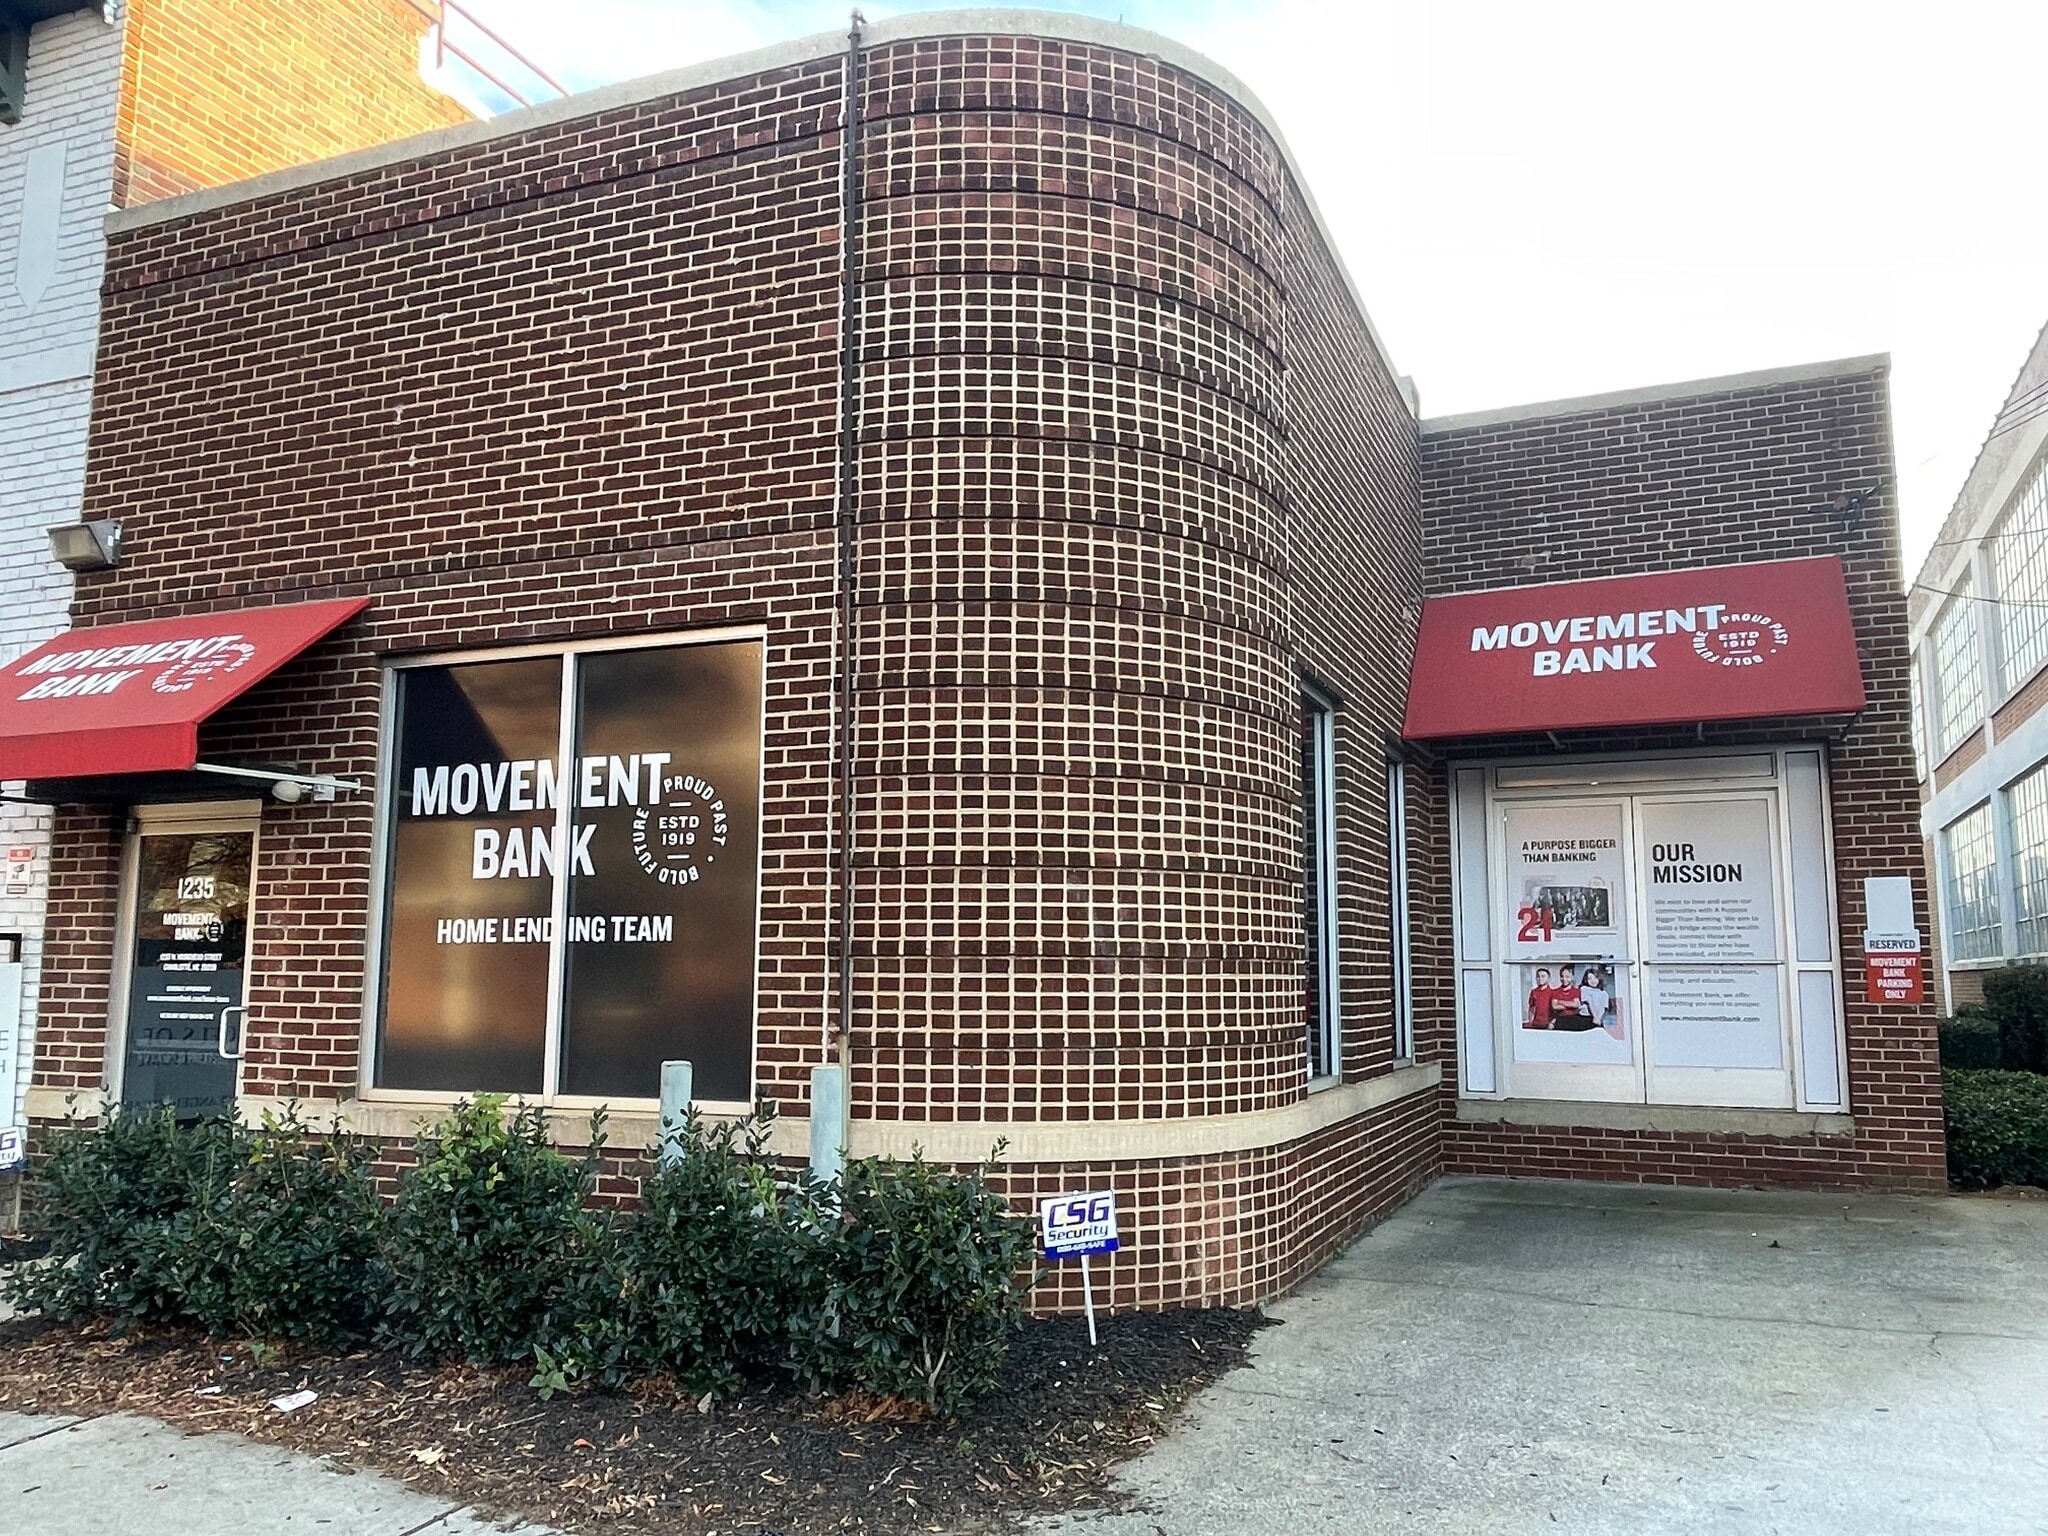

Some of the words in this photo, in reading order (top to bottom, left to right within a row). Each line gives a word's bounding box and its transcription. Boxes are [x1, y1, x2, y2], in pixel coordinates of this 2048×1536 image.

[1470, 604, 1726, 652] MOVEMENT
[1721, 613, 1772, 625] PROUD
[1768, 623, 1788, 645] PAST
[15, 634, 244, 677] MOVEMENT
[1533, 641, 1658, 677] BANK
[16, 668, 144, 701] BANK
[411, 753, 671, 816] MOVEMENT
[663, 775, 715, 801] PROUD
[709, 800, 728, 847] PAST
[659, 816, 699, 829] ESTD
[632, 807, 658, 875] FUTURE
[662, 832, 695, 846] 1919
[1522, 841, 1529, 851] A
[1531, 840, 1576, 850] PURPOSE
[1579, 839, 1616, 849] BIGGER
[472, 824, 598, 880] BANK
[1522, 853, 1549, 863] THAN
[1552, 852, 1597, 863] BANKING
[1652, 843, 1695, 862] OUR
[658, 865, 699, 885] BOLD
[1653, 863, 1743, 884] MISSION
[178, 877, 215, 899] 1235
[163, 913, 214, 926] MOVEMENT
[436, 918, 498, 944] HOME
[610, 915, 673, 942] TEAM
[174, 927, 202, 940] BANK
[1869, 939, 1916, 950] RESERVED
[1870, 958, 1917, 967] MOVEMENT
[1883, 968, 1906, 977] BANK
[1877, 979, 1913, 988] PARKING
[1885, 990, 1906, 999] ONLY
[1048, 1196, 1110, 1228] CSG
[1048, 1225, 1109, 1242] Security
